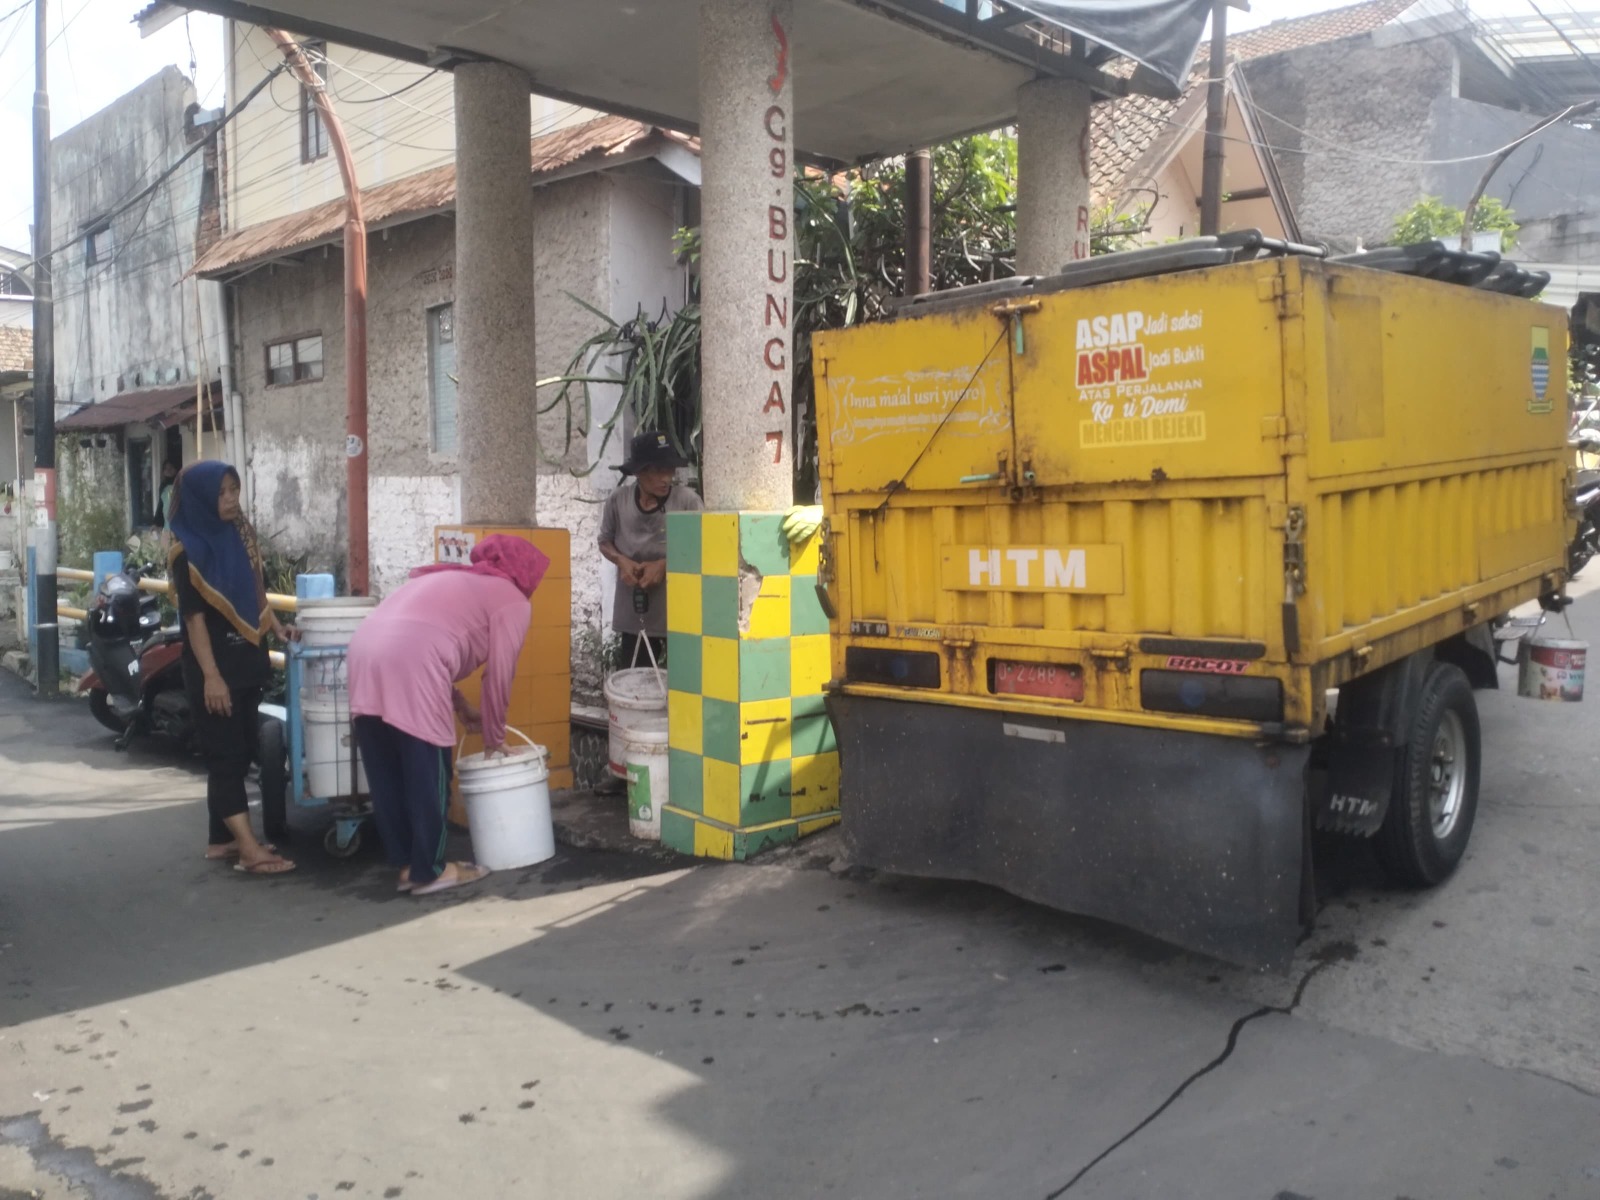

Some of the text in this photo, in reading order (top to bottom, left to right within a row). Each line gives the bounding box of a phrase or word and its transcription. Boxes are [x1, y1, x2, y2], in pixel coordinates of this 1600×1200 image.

[1076, 311, 1144, 350] ASAP
[1170, 309, 1203, 332] saksi
[1076, 343, 1149, 388] ASPAL
[1172, 344, 1204, 366] Bukti
[1140, 393, 1189, 419] Demi
[1082, 414, 1203, 445] MENCARI REJEKI
[968, 548, 1086, 588] HTM
[850, 622, 888, 635] HTM
[1329, 793, 1378, 816] HTM
